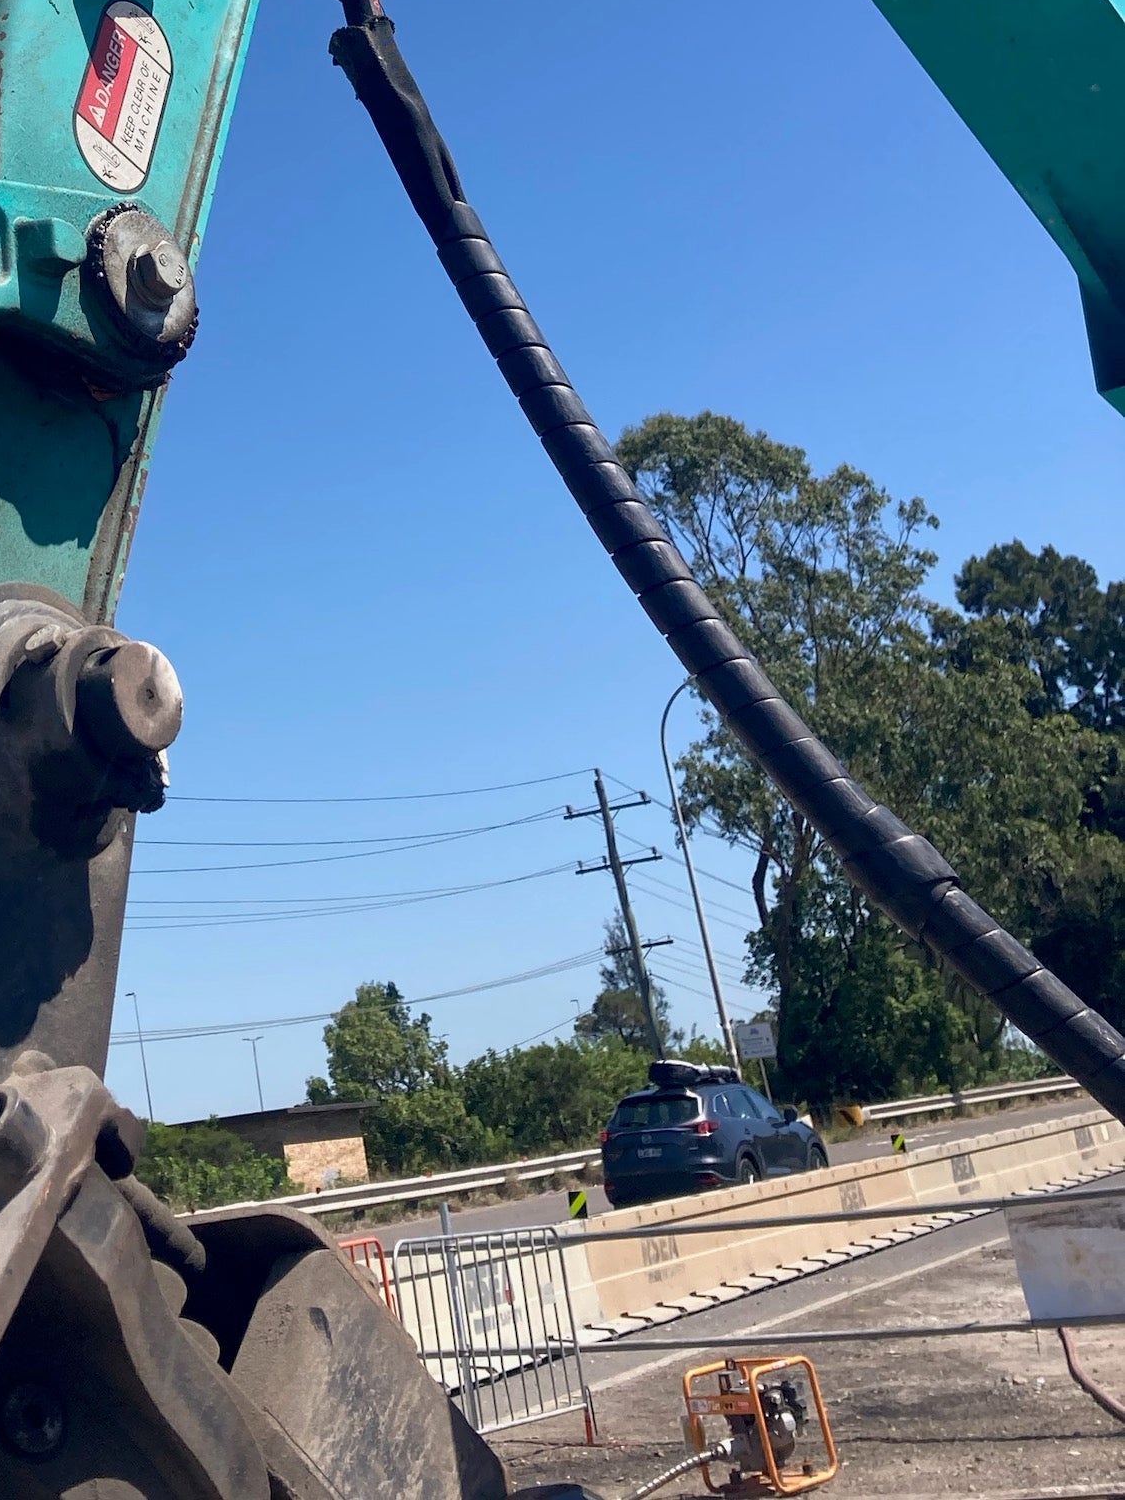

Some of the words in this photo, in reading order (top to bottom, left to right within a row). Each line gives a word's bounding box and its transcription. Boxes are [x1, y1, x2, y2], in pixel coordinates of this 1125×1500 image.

[96, 29, 126, 109] DANGER
[122, 115, 136, 148] KEEP
[131, 80, 146, 115] CLEAR
[142, 60, 151, 78] OF
[134, 71, 162, 153] MACHINE
